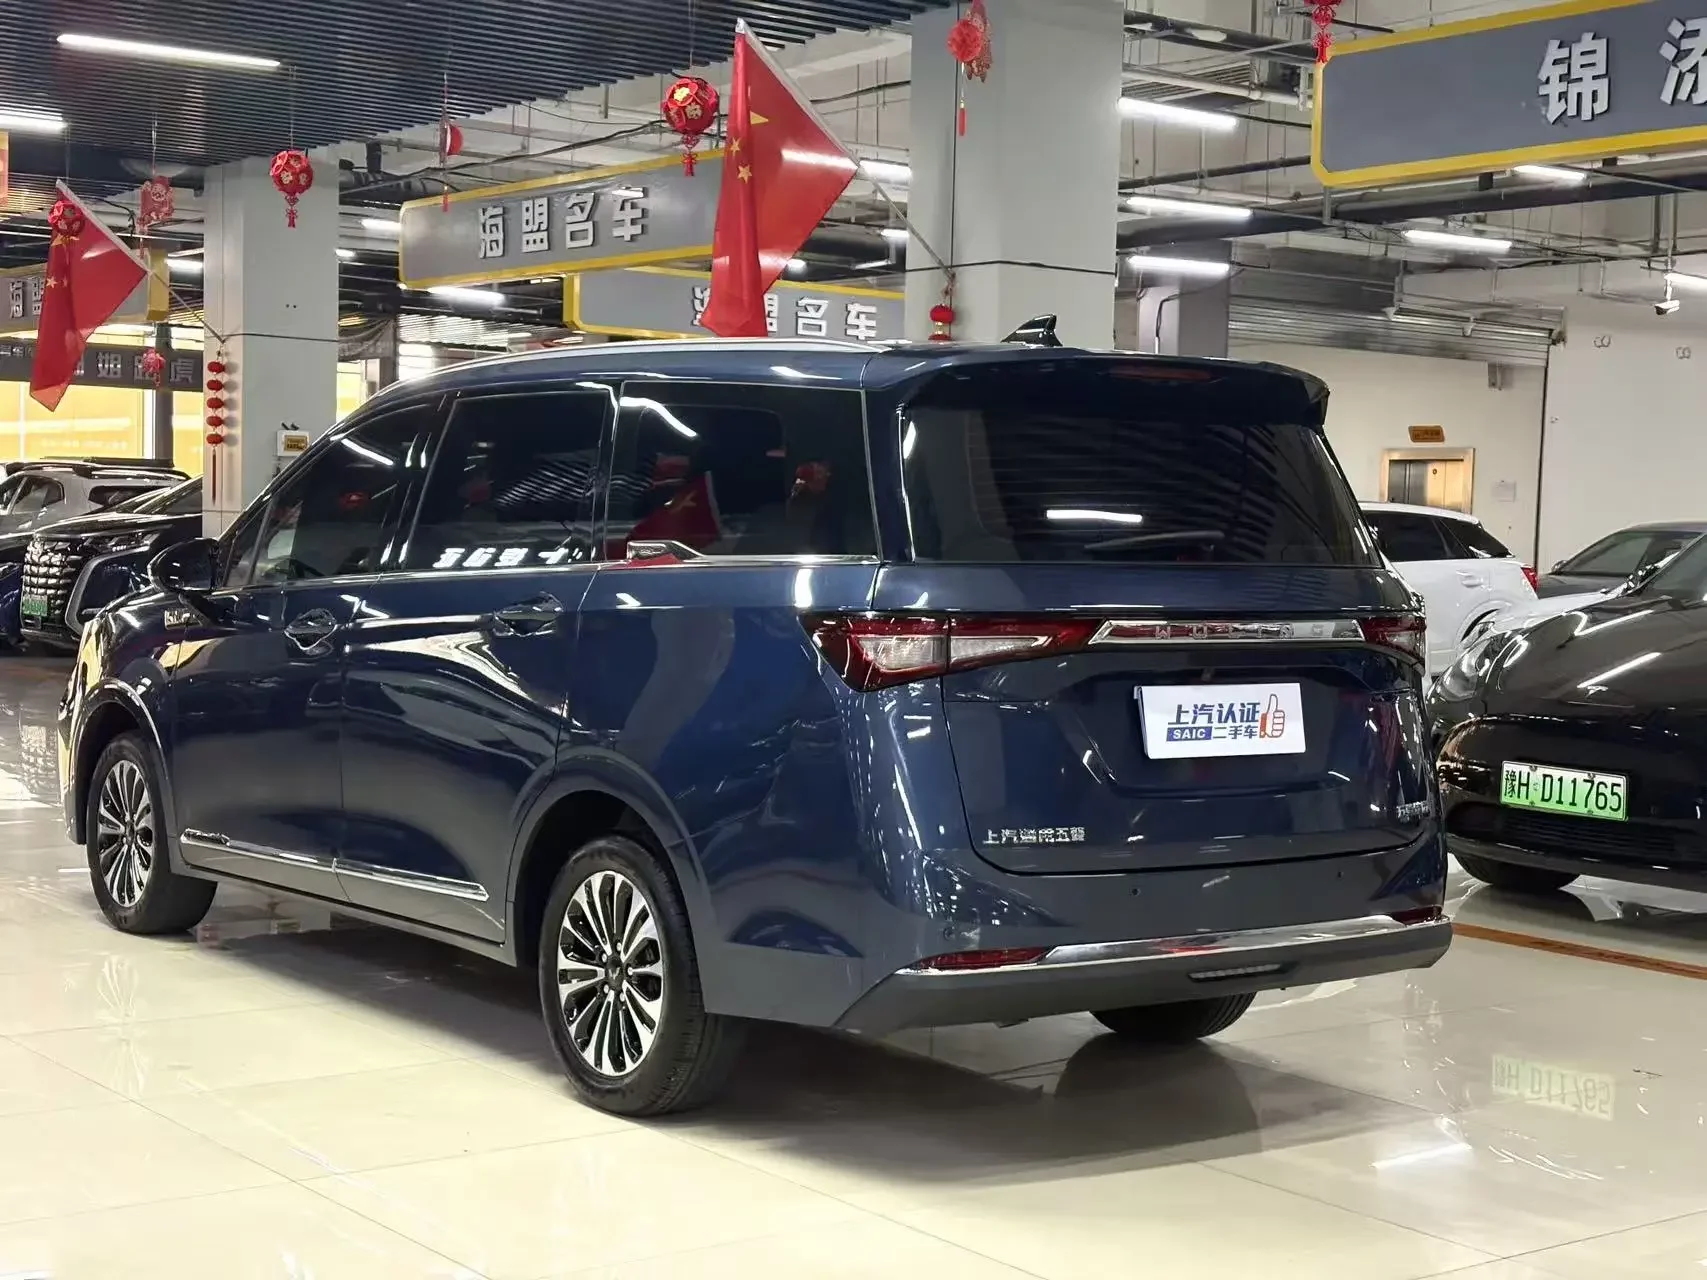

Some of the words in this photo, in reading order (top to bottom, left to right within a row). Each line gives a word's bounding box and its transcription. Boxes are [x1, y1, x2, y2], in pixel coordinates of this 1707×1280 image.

[479, 186, 645, 259] 海盟名车
[1168, 702, 1260, 725] 上汽认证
[1172, 729, 1206, 740] SAIC
[1213, 724, 1259, 740] 二手车
